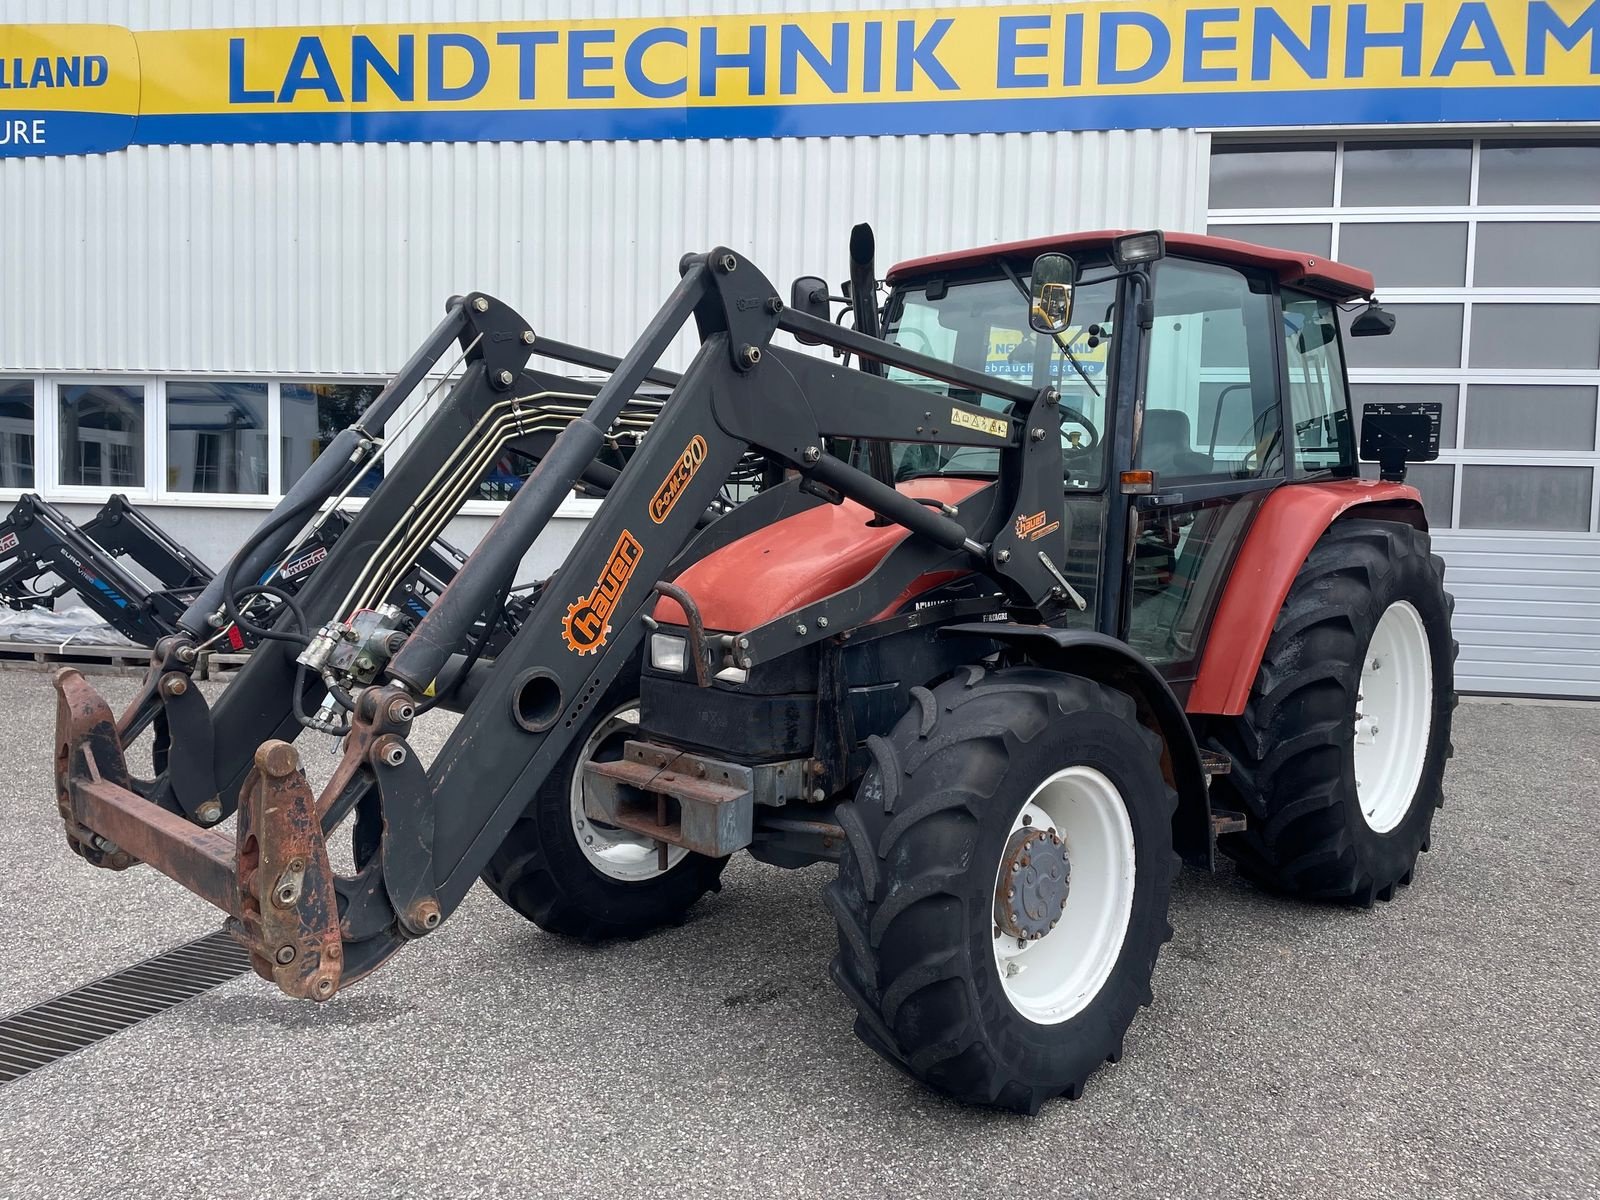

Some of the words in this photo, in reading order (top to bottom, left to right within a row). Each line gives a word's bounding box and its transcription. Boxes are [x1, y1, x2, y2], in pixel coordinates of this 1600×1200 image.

[229, 19, 962, 104] LANDTECHNIK
[997, 1, 1600, 88] EIDENHAM
[288, 553, 326, 576] HYDRAC
[574, 540, 634, 641] hauer
